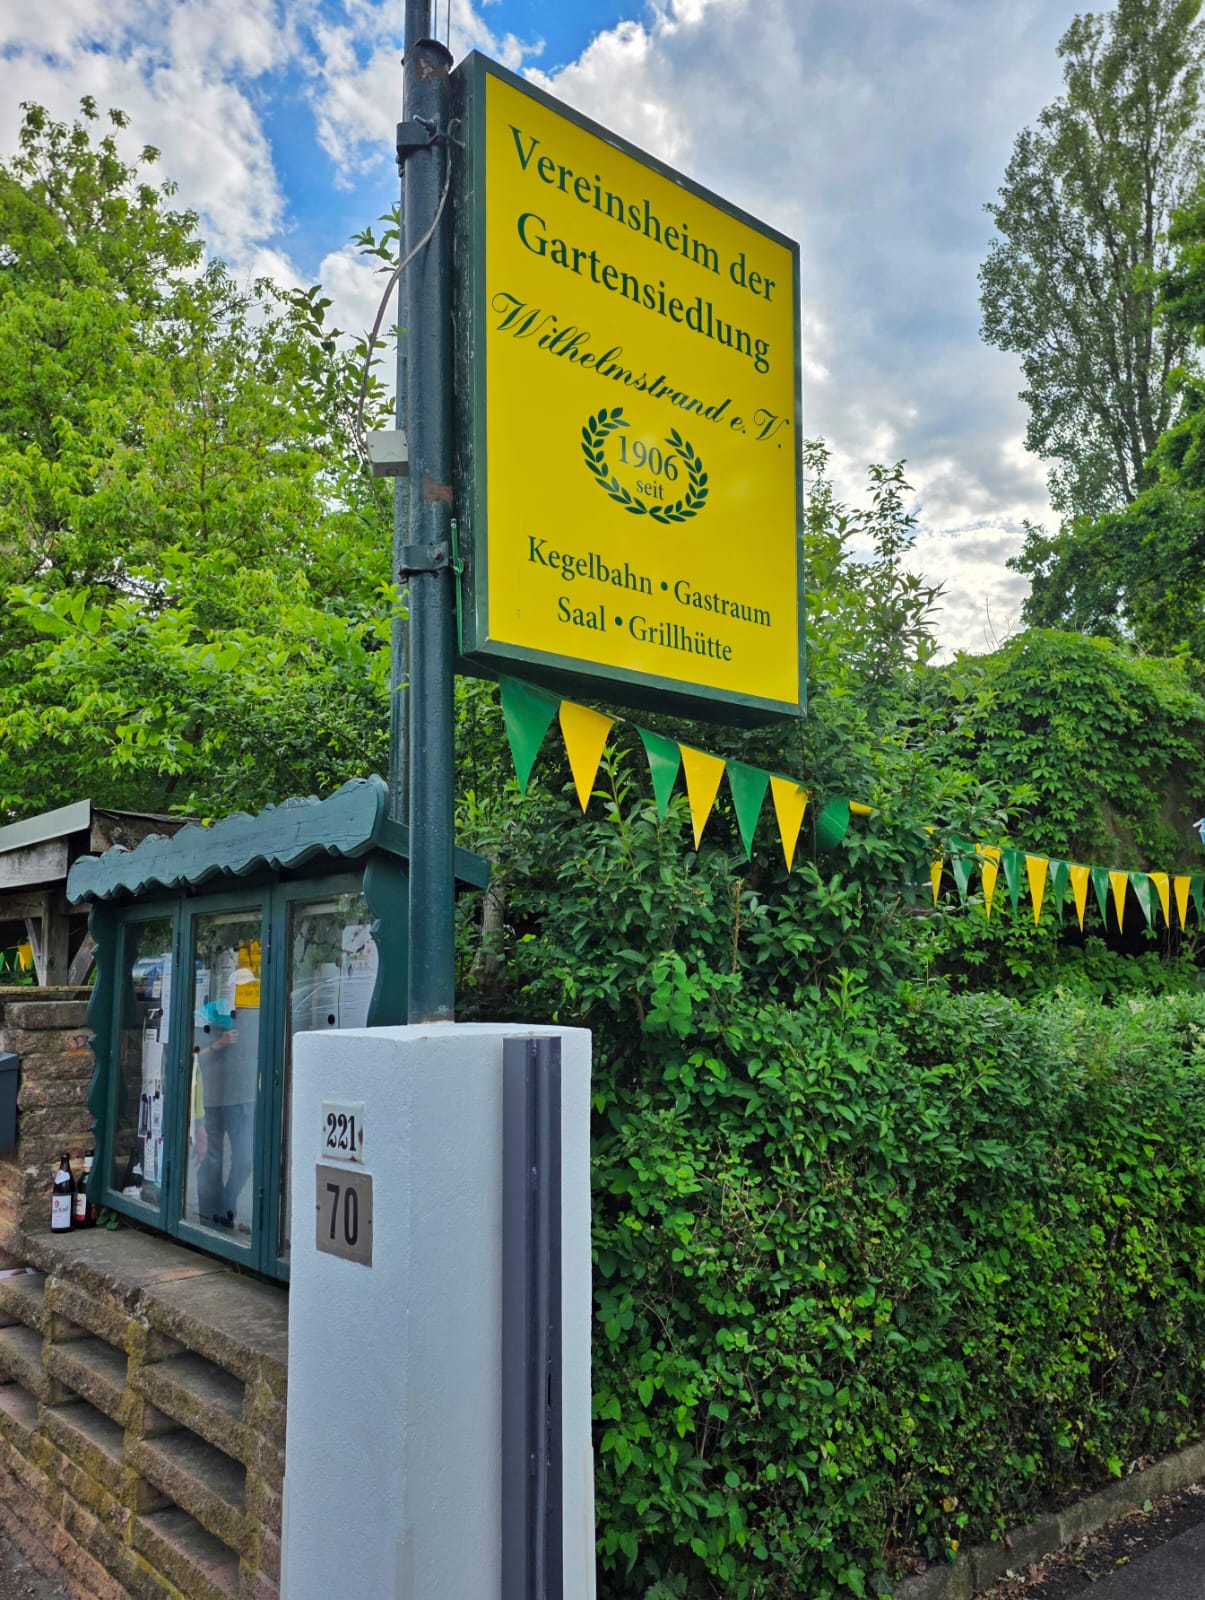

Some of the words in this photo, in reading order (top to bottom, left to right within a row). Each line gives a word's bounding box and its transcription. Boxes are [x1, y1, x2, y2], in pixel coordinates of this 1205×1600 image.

[507, 123, 721, 276] Vereinsheim
[729, 252, 777, 303] der
[517, 212, 772, 375] Gartensiedlung
[491, 291, 733, 423] Wilhelmstrand
[617, 435, 679, 482] 1906
[636, 478, 665, 501] seit
[527, 535, 654, 596] Kegelbahn
[673, 580, 772, 628] Gastraum
[557, 595, 606, 632] Saal
[628, 615, 733, 662] Grillhütte
[326, 1112, 357, 1152] 221
[326, 1182, 359, 1246] 70
